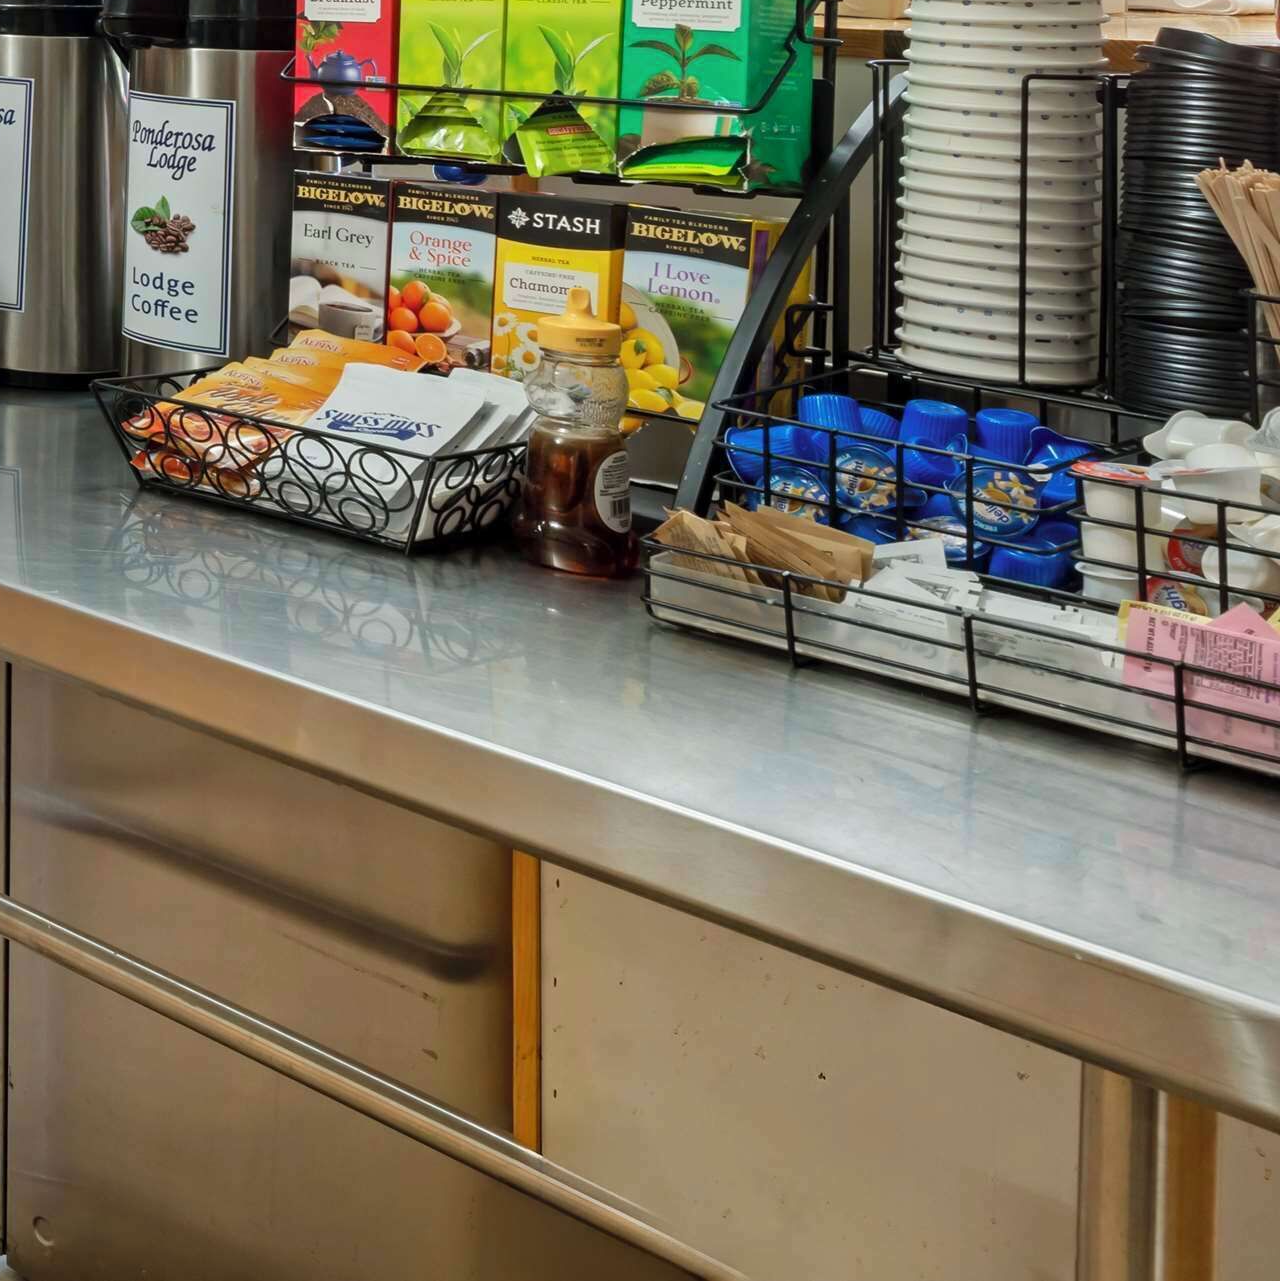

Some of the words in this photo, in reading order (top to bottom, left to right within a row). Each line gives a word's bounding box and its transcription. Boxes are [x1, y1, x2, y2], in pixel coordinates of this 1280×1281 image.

[132, 120, 216, 152] Ponderosa
[146, 146, 197, 181] Lodge
[297, 185, 385, 208] BIGELOW
[398, 196, 494, 220] BIGELOW
[532, 212, 600, 235] STASH
[303, 223, 332, 241] Earl
[335, 228, 375, 249] Grey
[409, 230, 473, 254] Orange
[630, 221, 746, 252] BIGELOW
[409, 246, 421, 261] &
[426, 248, 472, 267] Spice
[132, 266, 195, 297] Lodge
[653, 262, 662, 277] I
[666, 263, 711, 285] Love
[509, 277, 582, 296] Chamom
[647, 278, 714, 303] Lemon
[131, 293, 199, 324] Coffee
[301, 335, 340, 352] ALPINE
[276, 354, 318, 367] ALPINE
[226, 368, 264, 386] ALPINE
